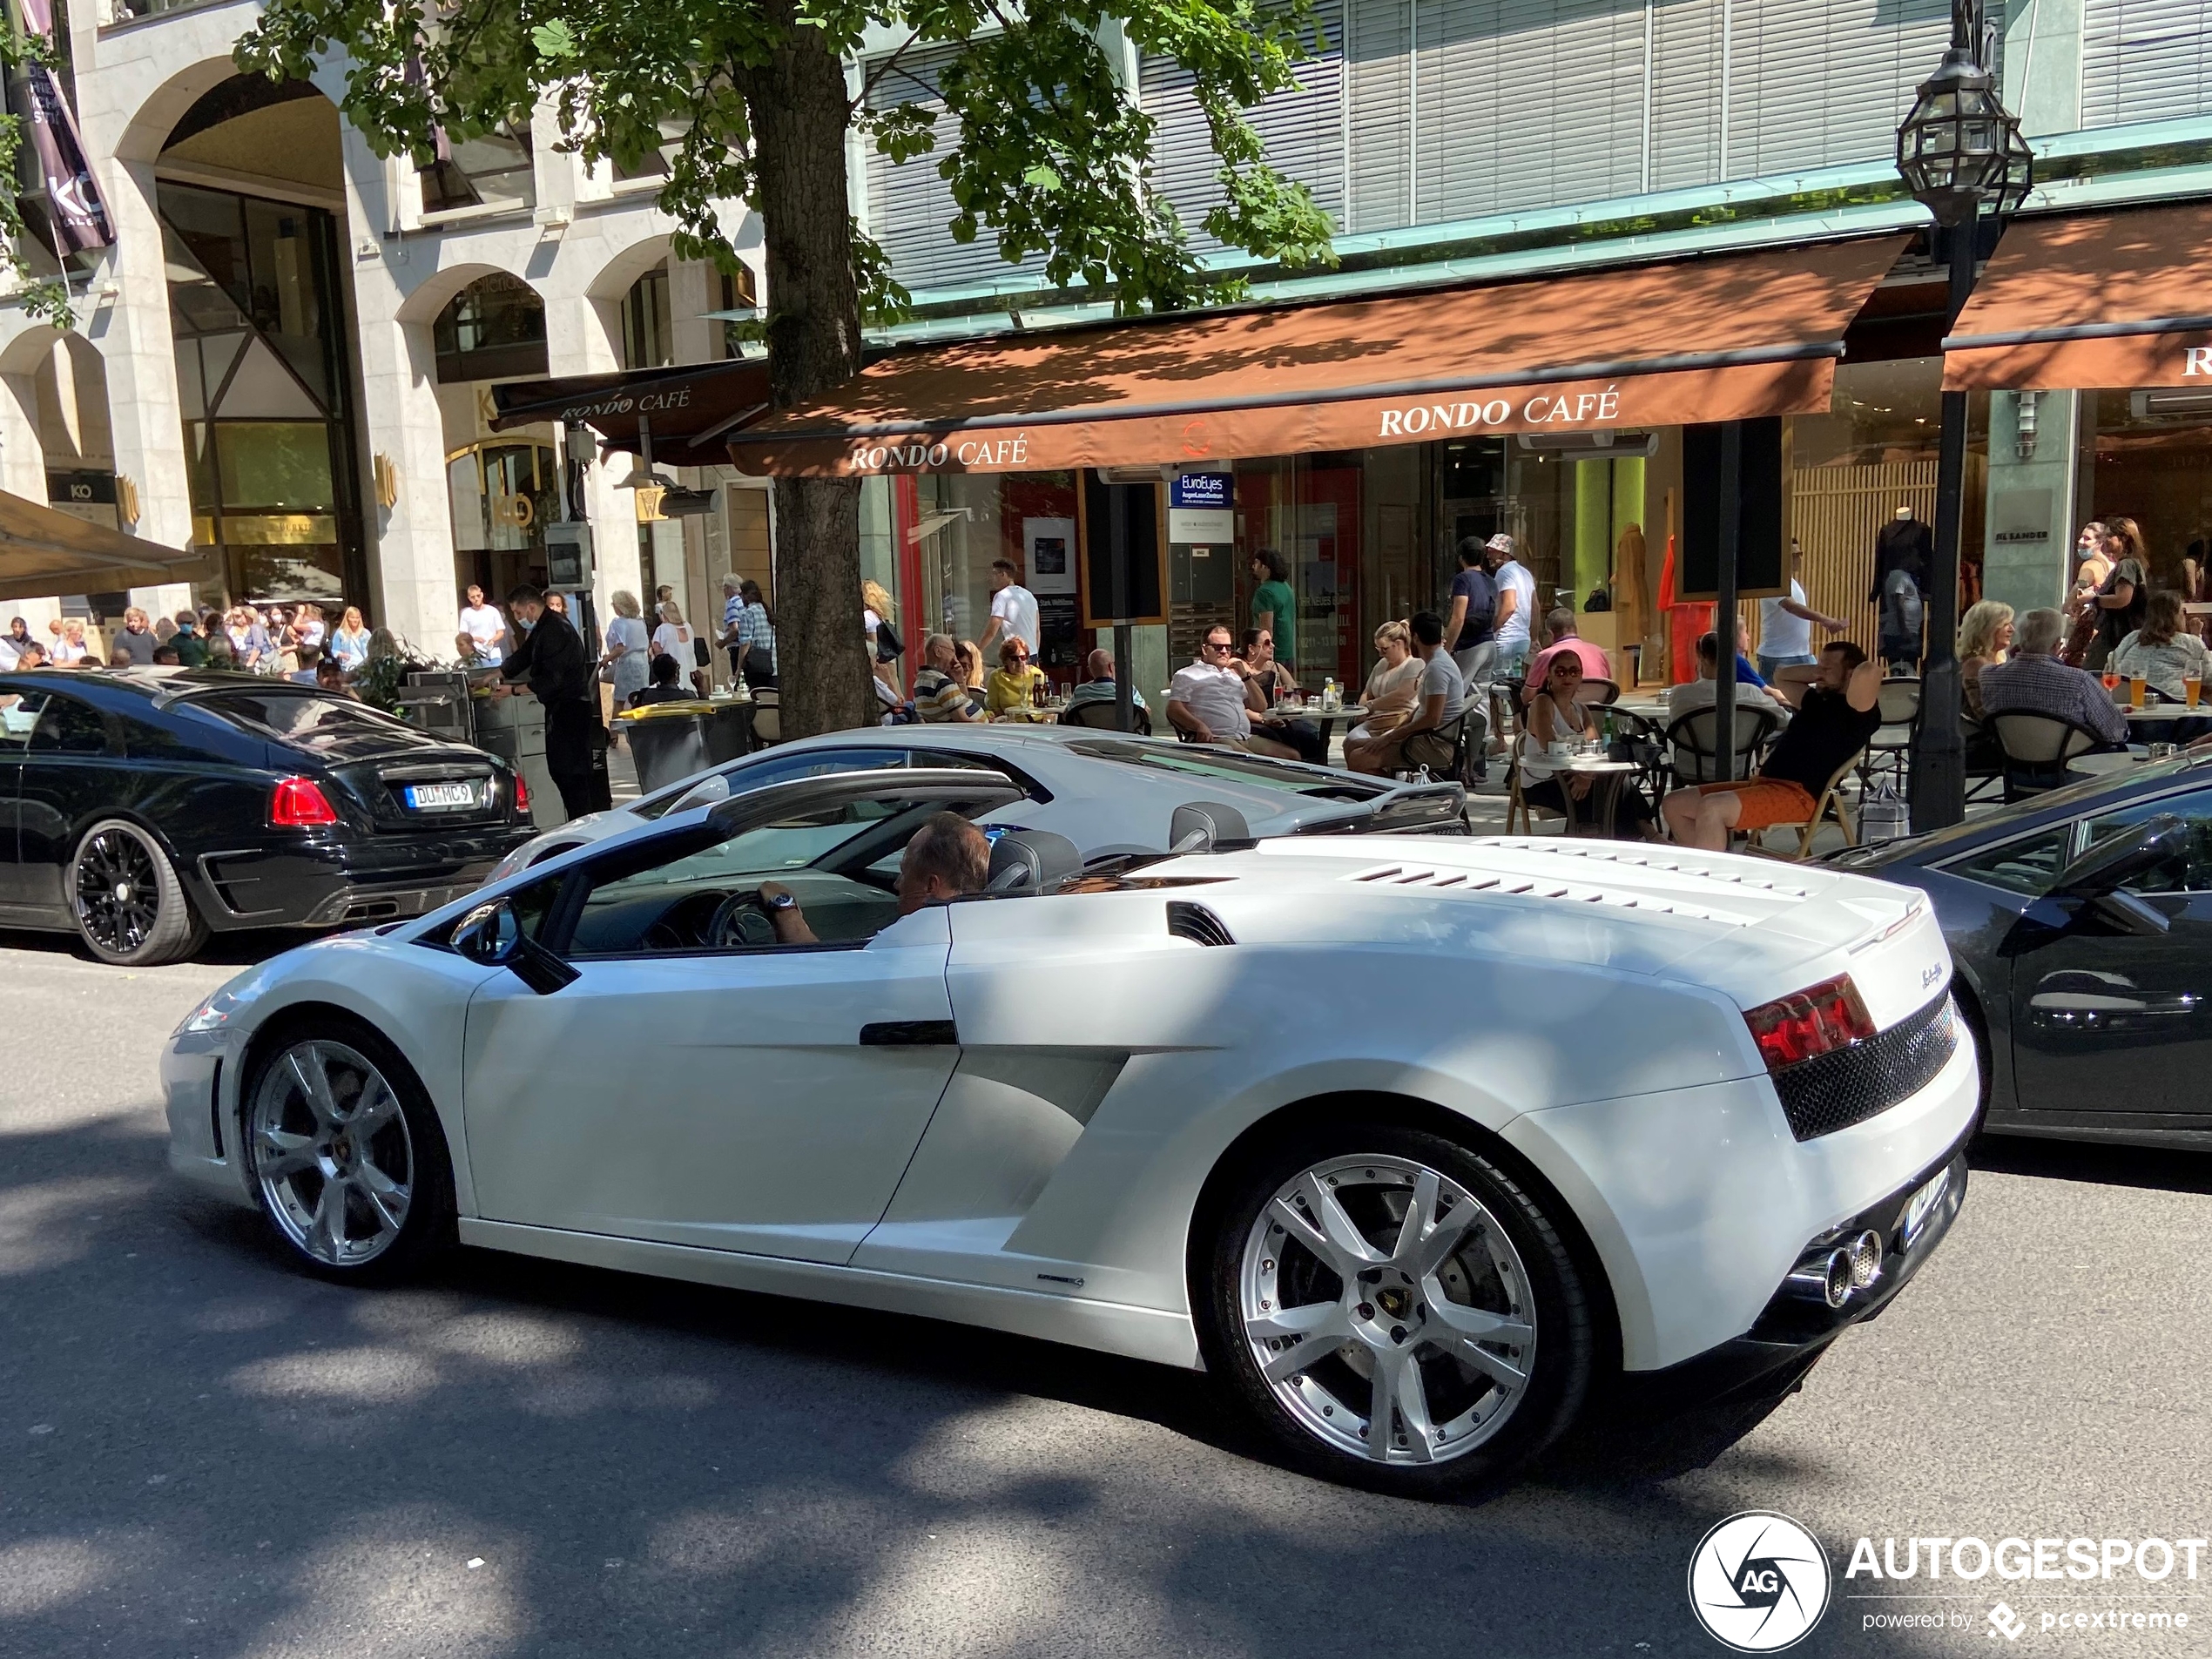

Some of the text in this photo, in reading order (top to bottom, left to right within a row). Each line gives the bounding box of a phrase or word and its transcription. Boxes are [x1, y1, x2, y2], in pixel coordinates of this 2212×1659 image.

[560, 385, 691, 419] RONDO CAFÉ
[1378, 385, 1619, 437] RONDO CAFÉ
[847, 433, 1028, 469] RONDO CAFÉ
[1182, 475, 1223, 493] EuroEyes
[2009, 530, 2048, 540] SANDER
[418, 787, 436, 804] DU
[442, 786, 461, 803] MC
